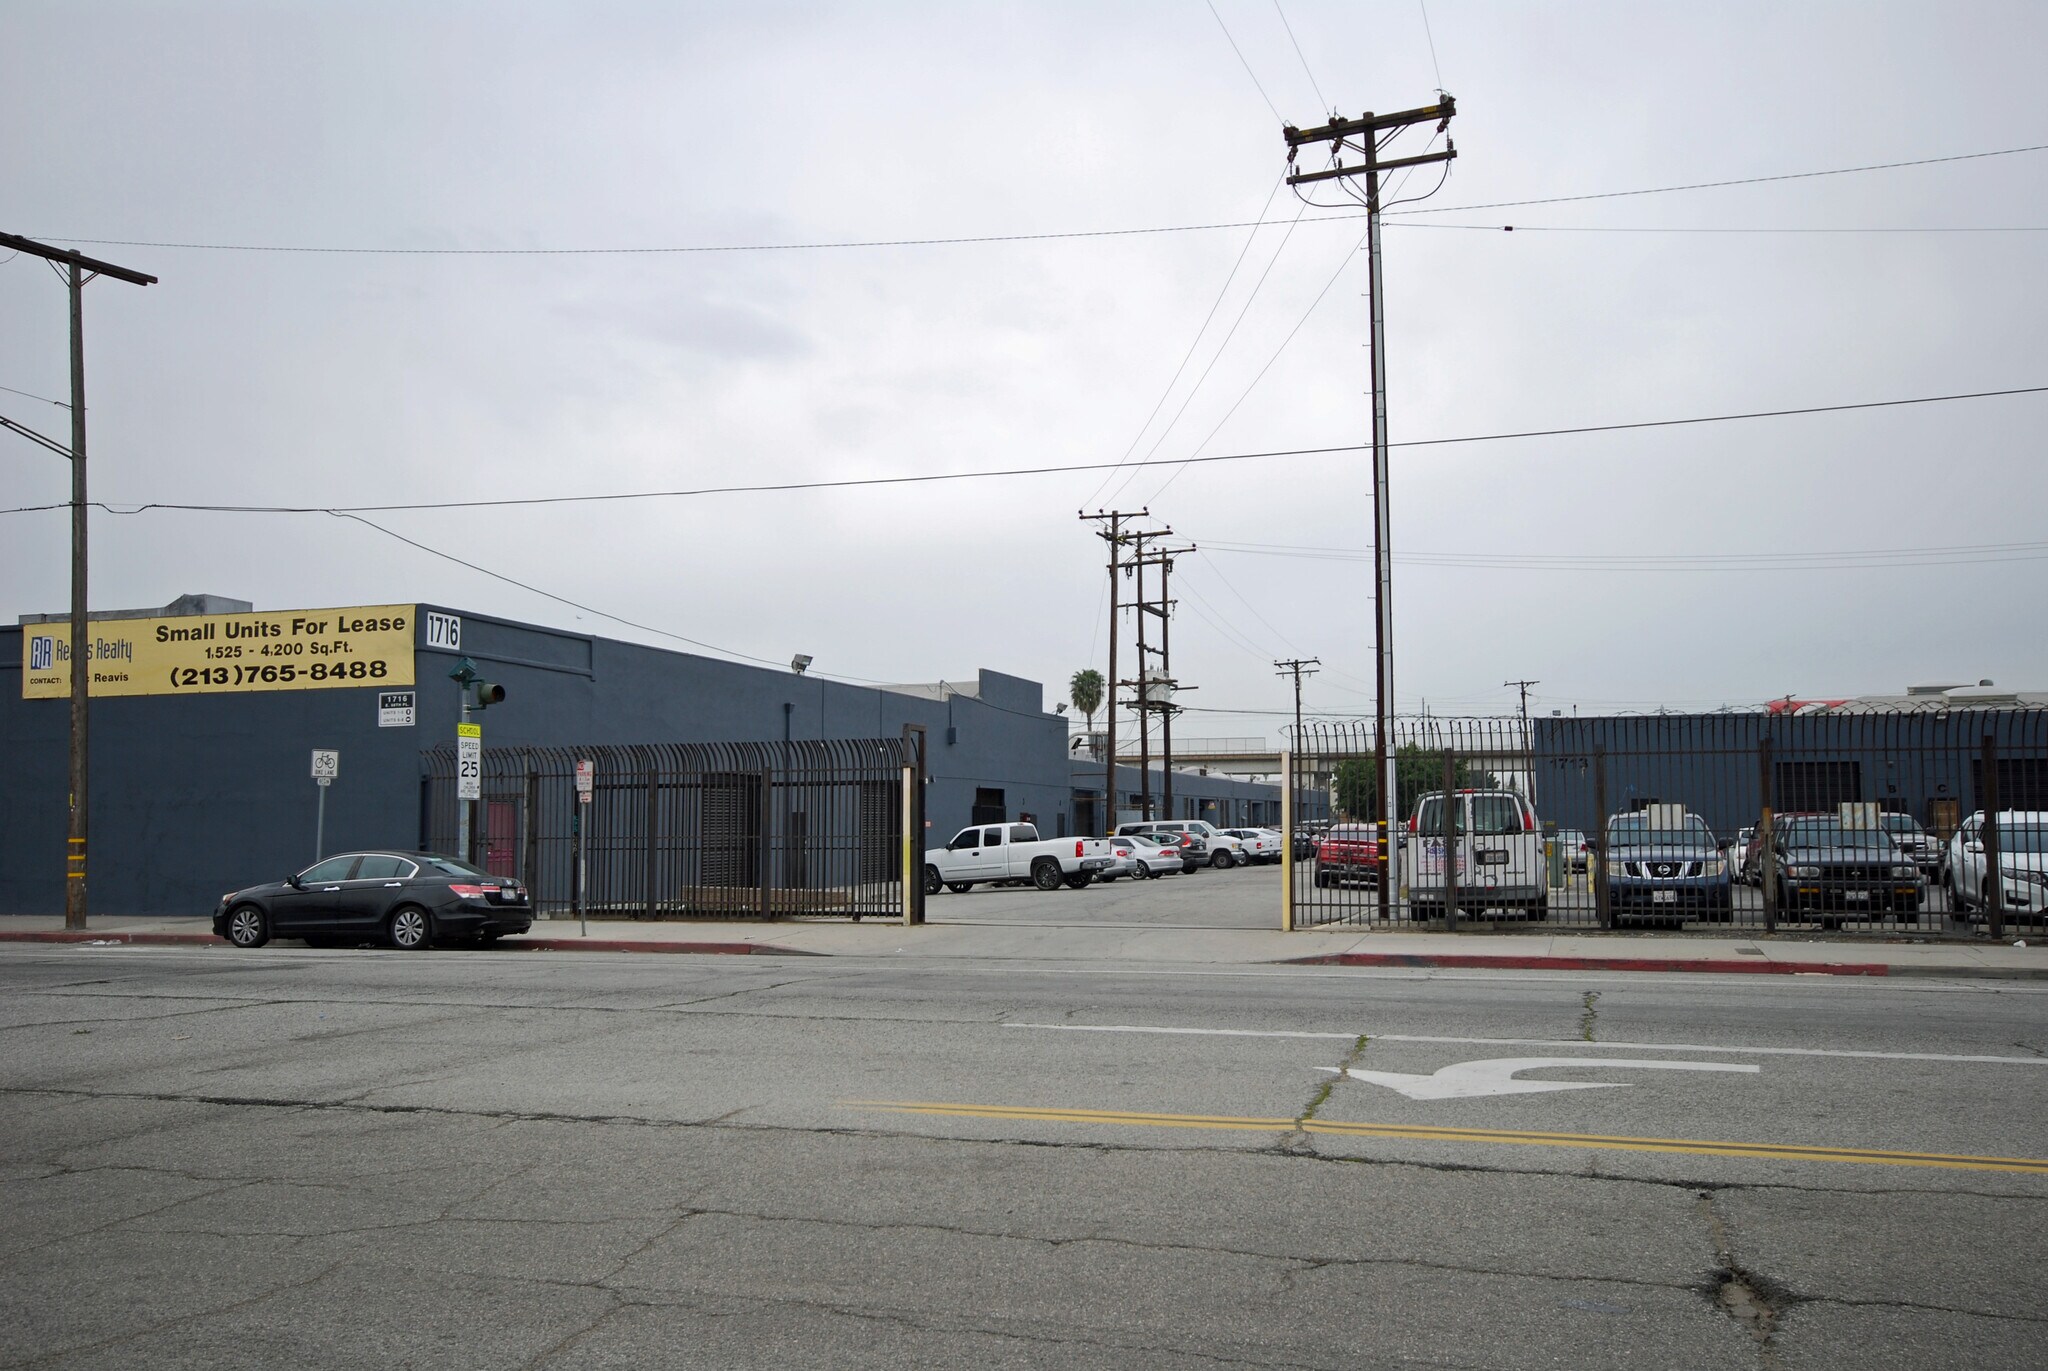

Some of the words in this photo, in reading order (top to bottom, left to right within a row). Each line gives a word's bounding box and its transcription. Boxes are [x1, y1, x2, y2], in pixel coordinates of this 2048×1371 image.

[156, 622, 215, 642] Small
[225, 621, 282, 639] Units
[292, 618, 328, 636] For
[338, 616, 406, 633] Lease
[429, 615, 459, 646] 1716
[56, 639, 93, 661] Res
[97, 638, 132, 663] Realty
[205, 645, 242, 659] 1,525
[261, 643, 303, 657] 4,200
[310, 640, 353, 656] Sq.Ft.
[94, 672, 129, 683] Reavis
[170, 660, 388, 688] (213)765-8488
[30, 677, 62, 685] CONTACT:
[387, 695, 408, 703] 1716
[460, 726, 480, 736] SCHOOL
[461, 741, 479, 750] SPEED
[462, 751, 477, 759] LIMIT
[461, 761, 479, 778] 25
[1888, 784, 1896, 793] B
[1937, 784, 1946, 792] C
